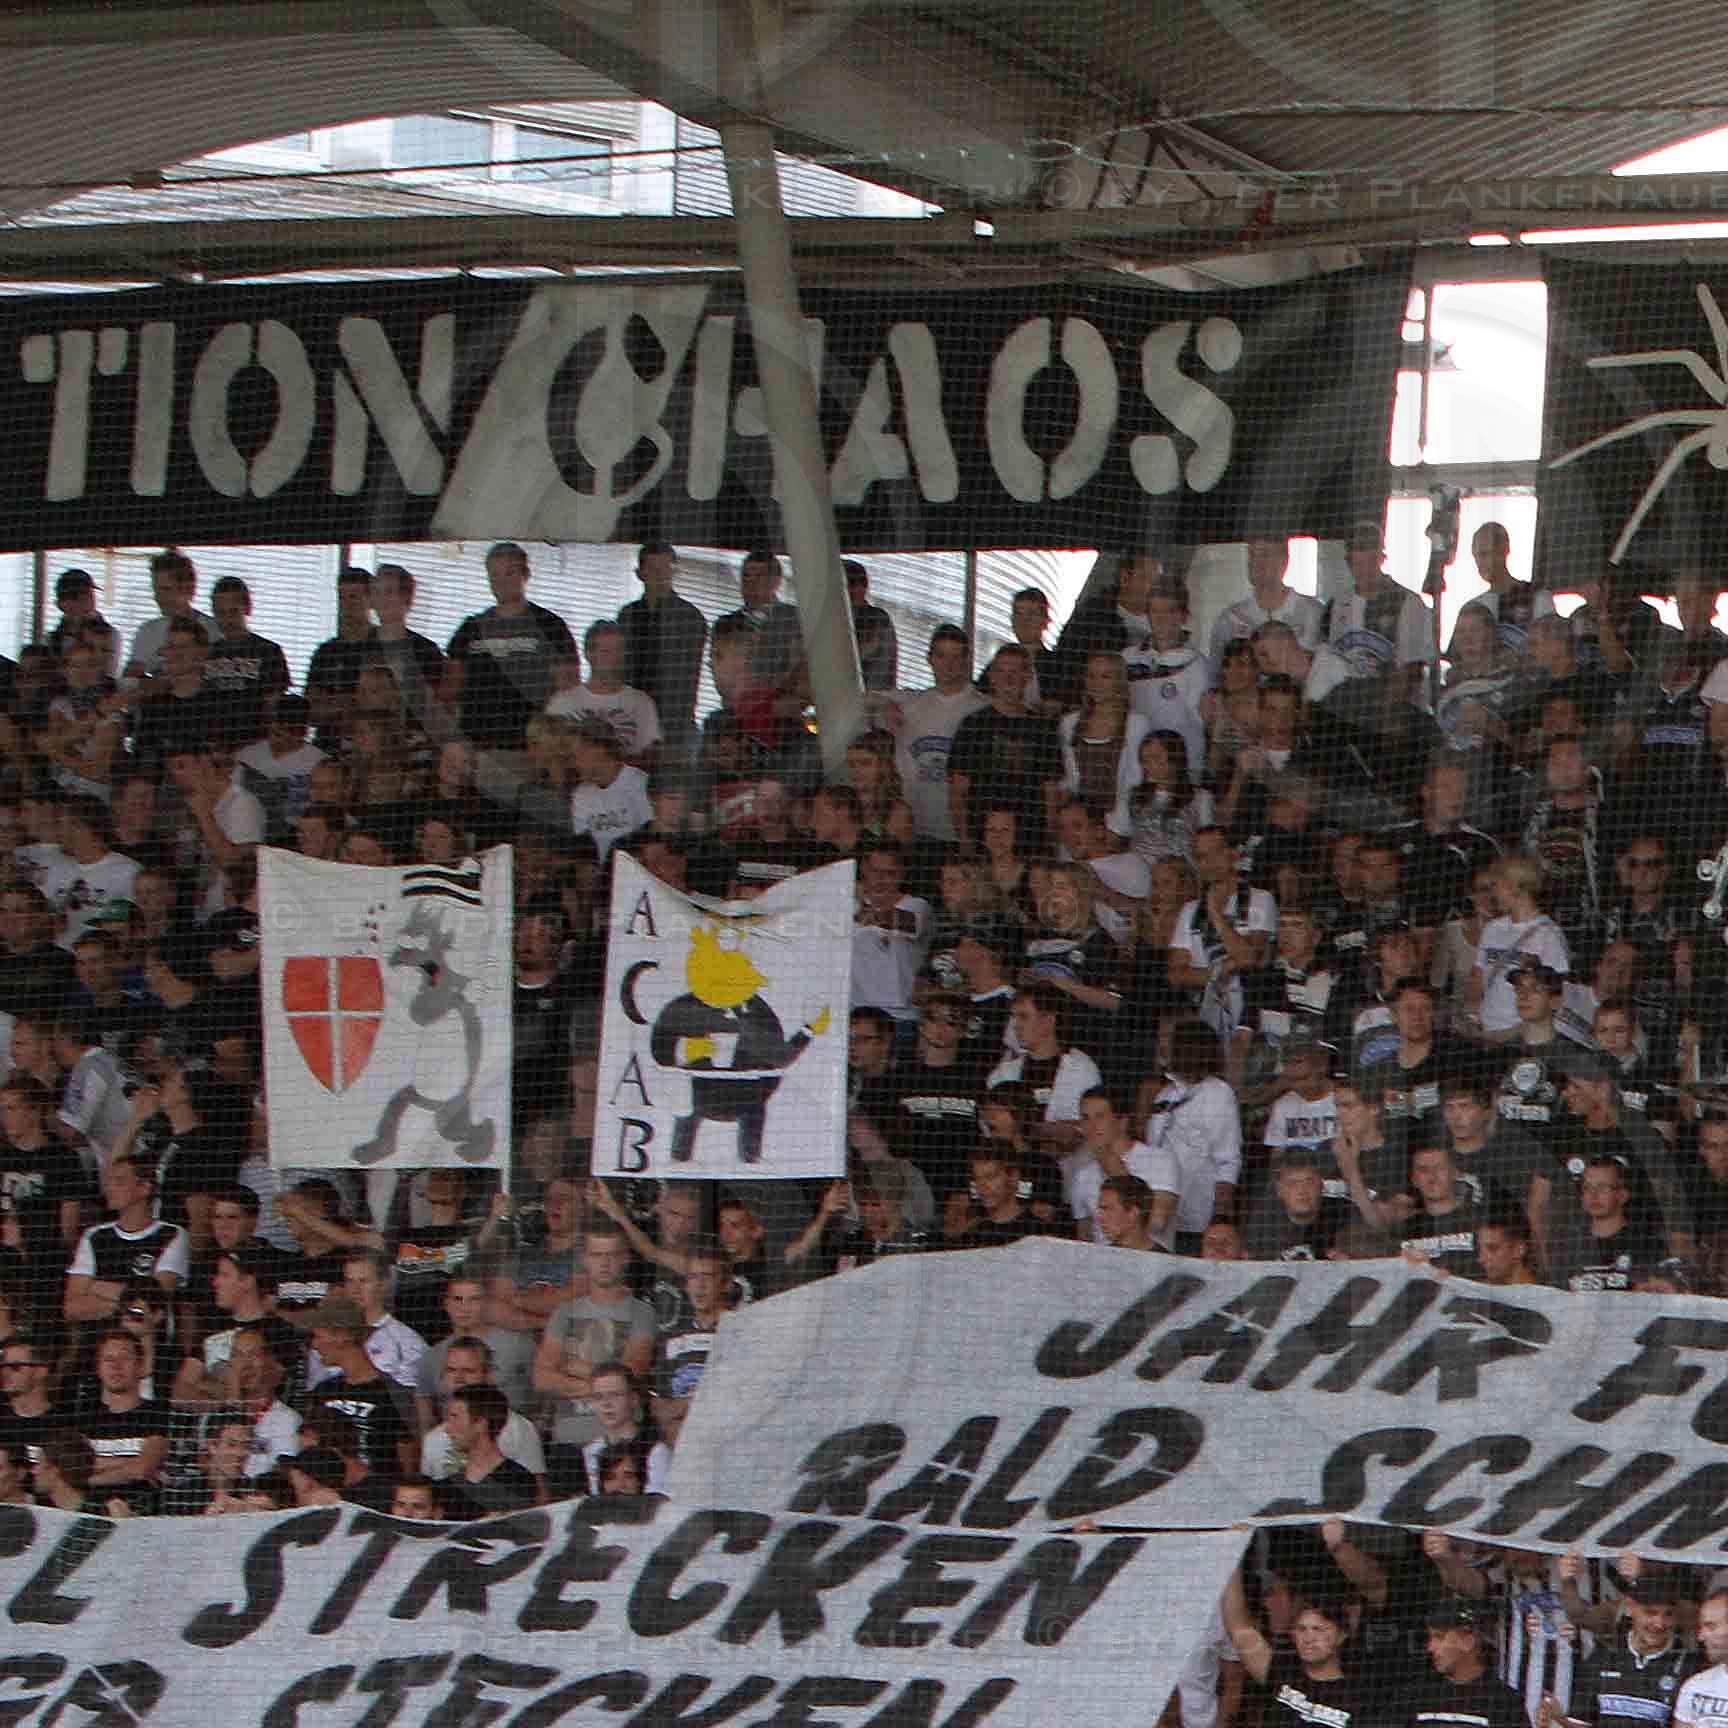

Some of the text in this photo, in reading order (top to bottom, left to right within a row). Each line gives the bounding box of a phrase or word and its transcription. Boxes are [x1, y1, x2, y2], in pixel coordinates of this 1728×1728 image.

[1034, 1273, 1553, 1403] JAHR
[794, 1404, 1208, 1529] BALD
[184, 1493, 1150, 1651] STRECKEN
